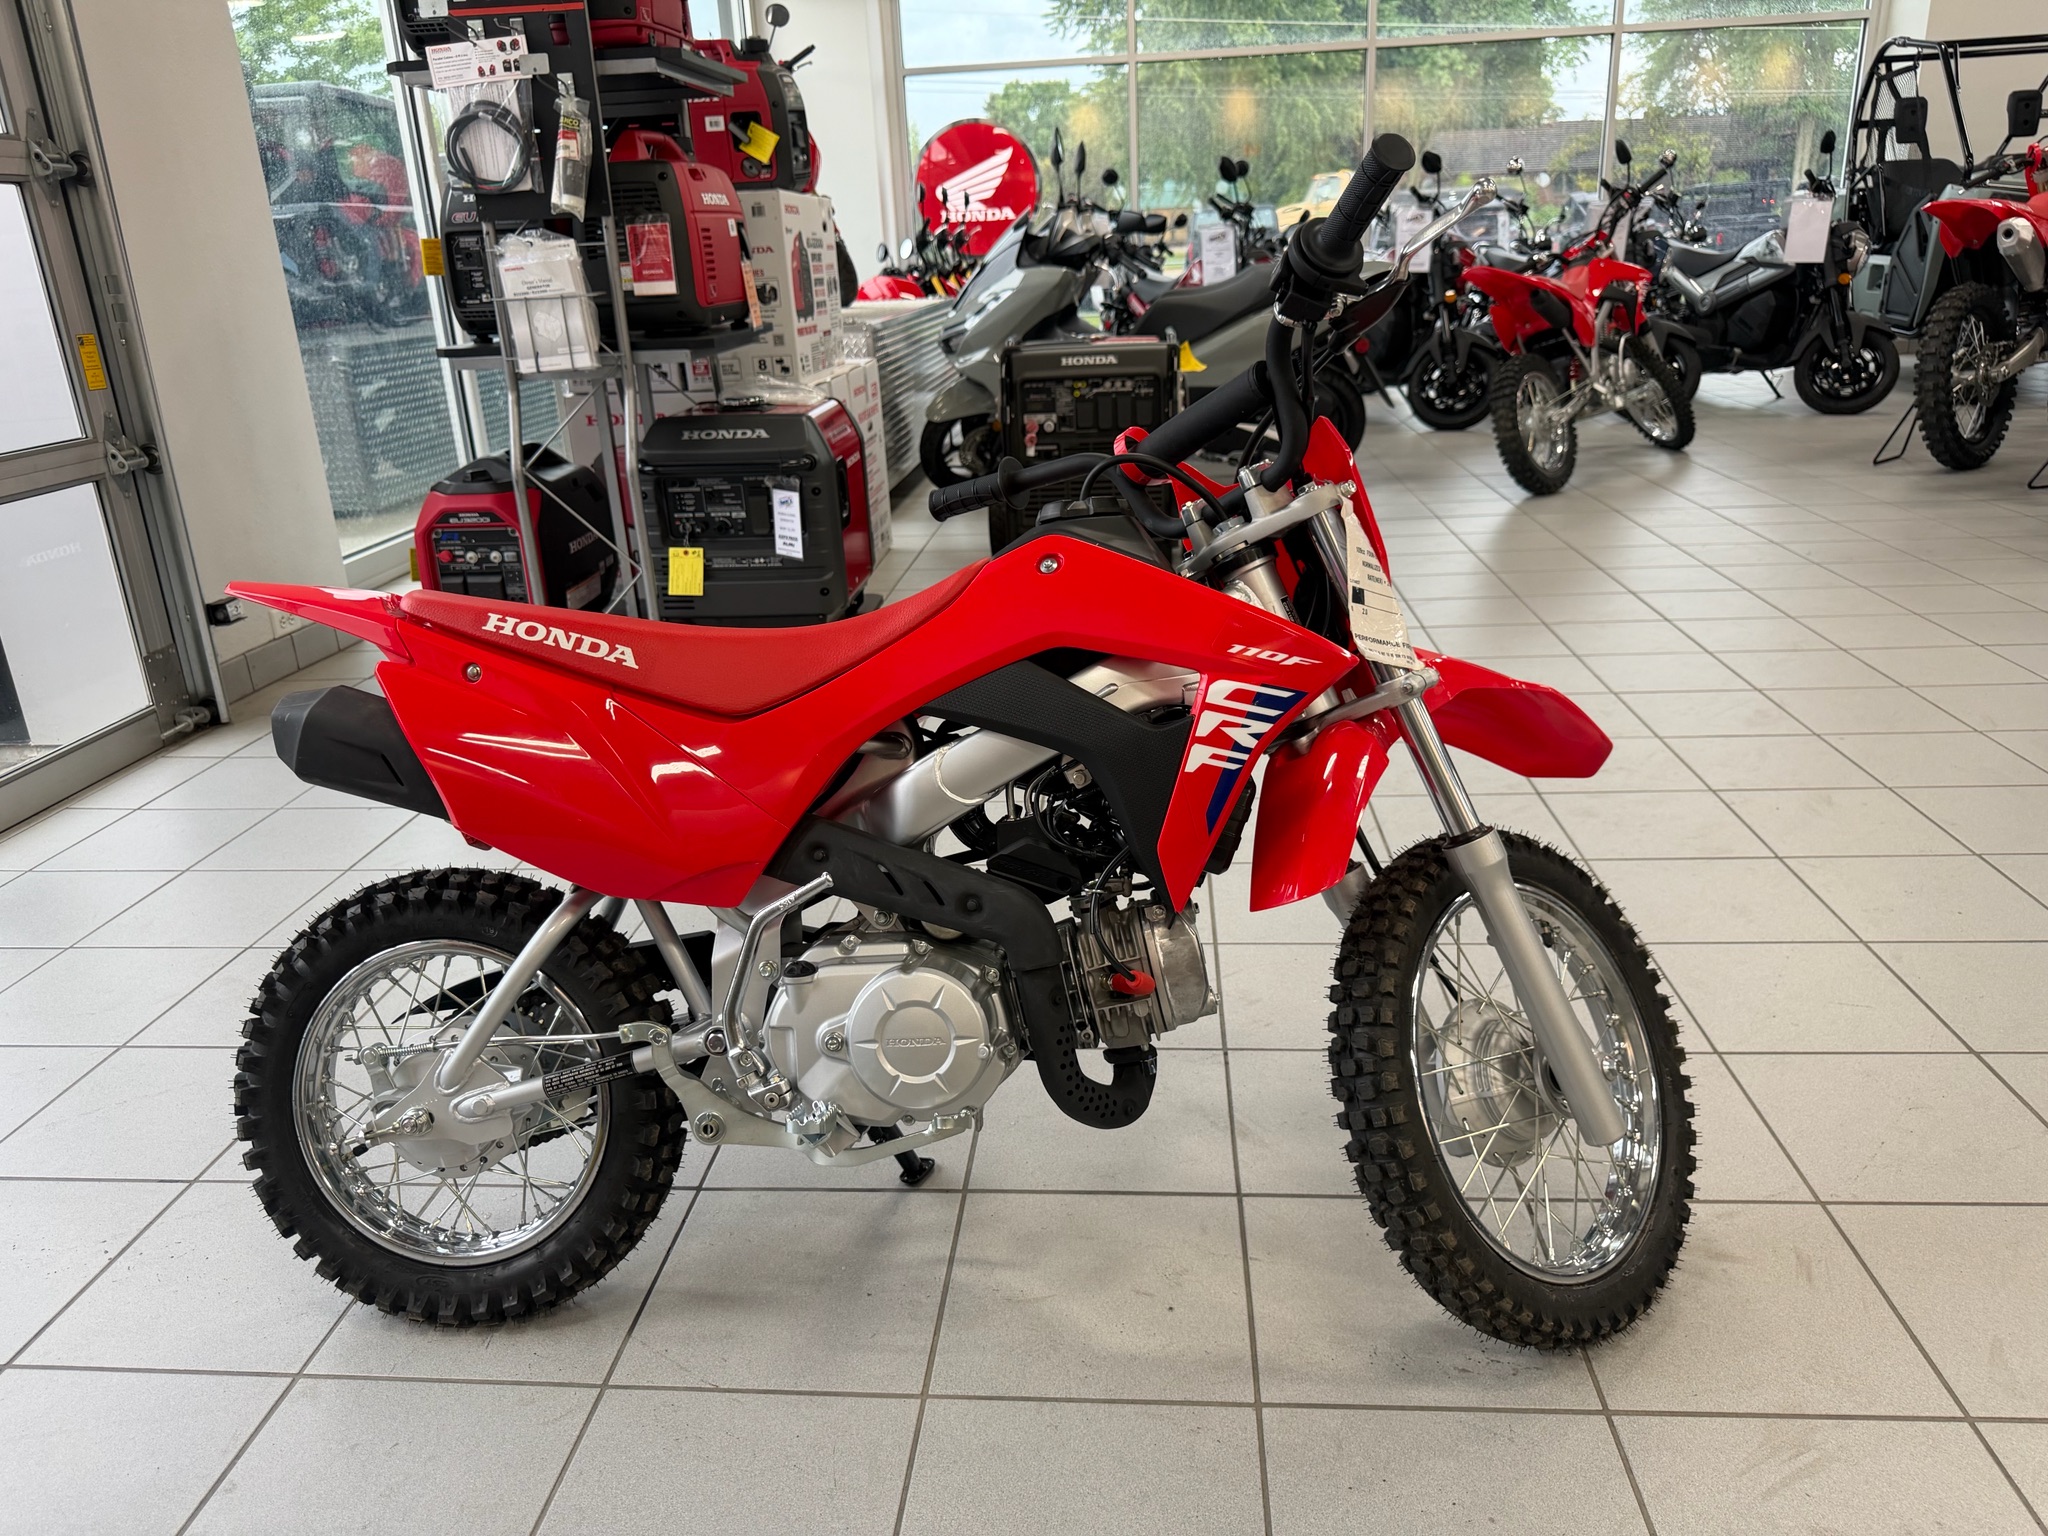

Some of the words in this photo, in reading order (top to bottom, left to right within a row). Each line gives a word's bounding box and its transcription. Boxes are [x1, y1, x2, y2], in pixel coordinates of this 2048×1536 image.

[701, 193, 730, 206] HONDA
[940, 206, 1017, 223] HONDA
[758, 359, 767, 371] 8
[1061, 354, 1119, 367] HONDA
[681, 428, 771, 441] HONDA
[481, 612, 639, 669] HONDA
[1226, 644, 1323, 665] 110F
[1184, 679, 1296, 773] CRF
[886, 1037, 947, 1048] HONDA
